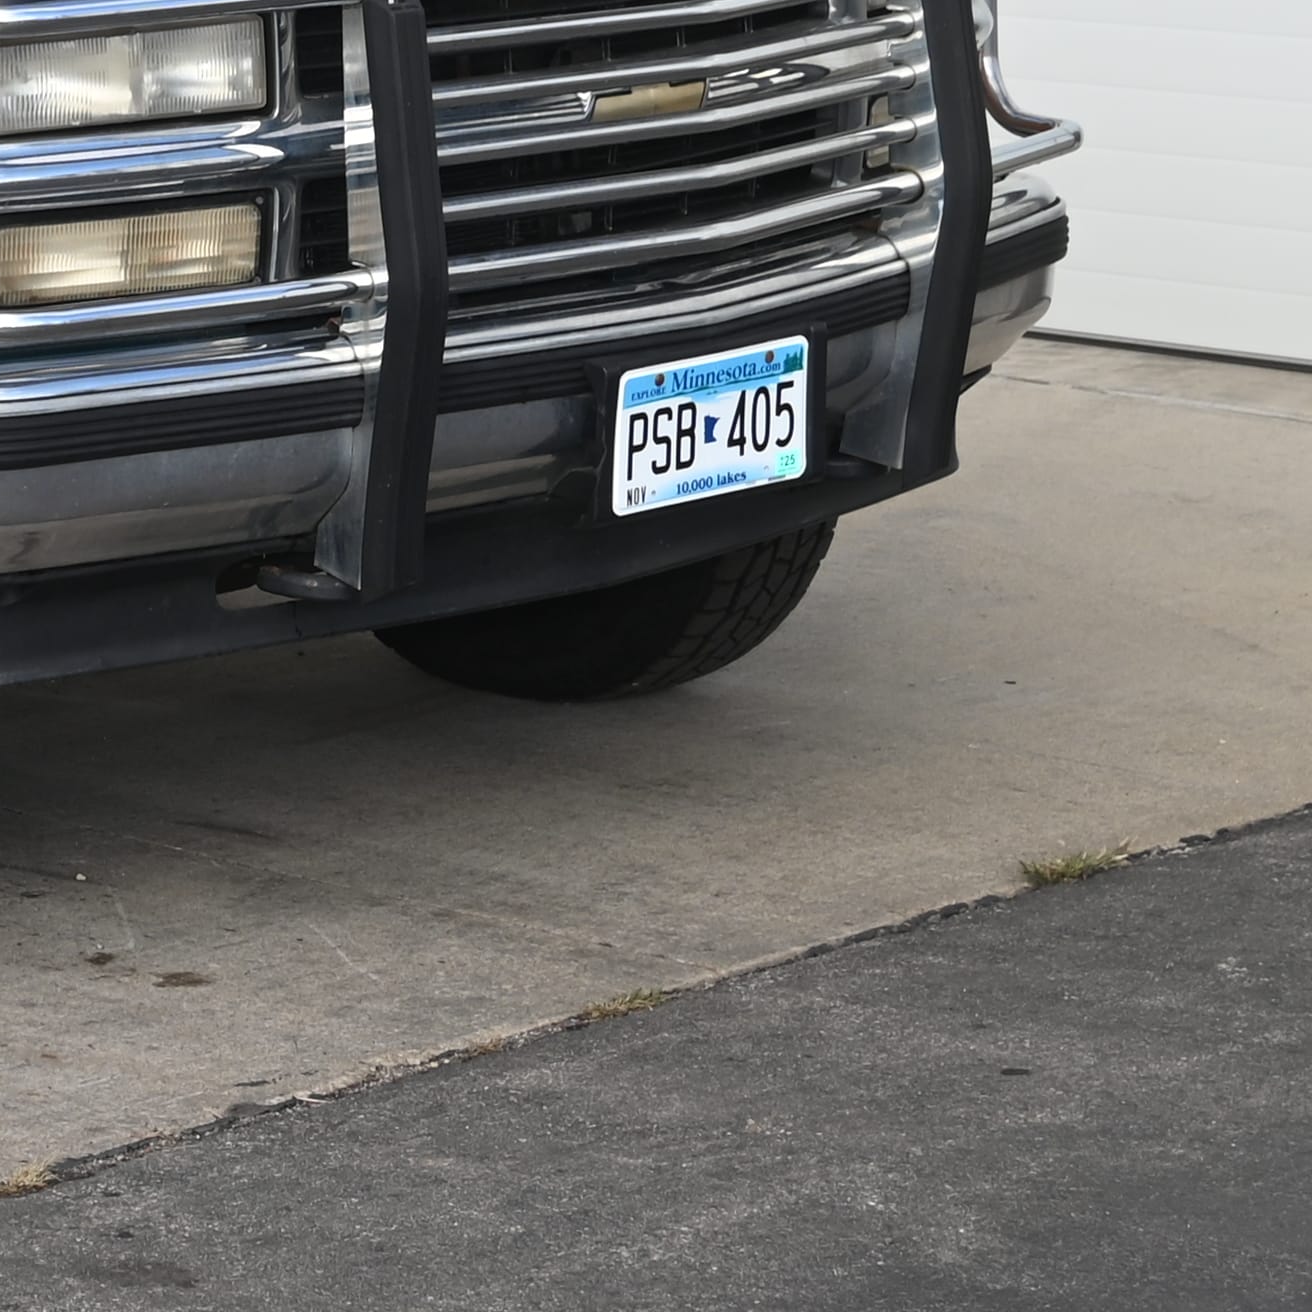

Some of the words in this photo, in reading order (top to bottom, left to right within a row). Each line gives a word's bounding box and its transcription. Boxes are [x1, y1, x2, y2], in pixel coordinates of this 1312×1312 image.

[631, 387, 666, 402] EXPLORE
[626, 401, 697, 481] PSB
[727, 380, 795, 457] 405
[676, 478, 714, 496] 10,000
[717, 470, 747, 487] lakes
[626, 486, 647, 507] NOV
